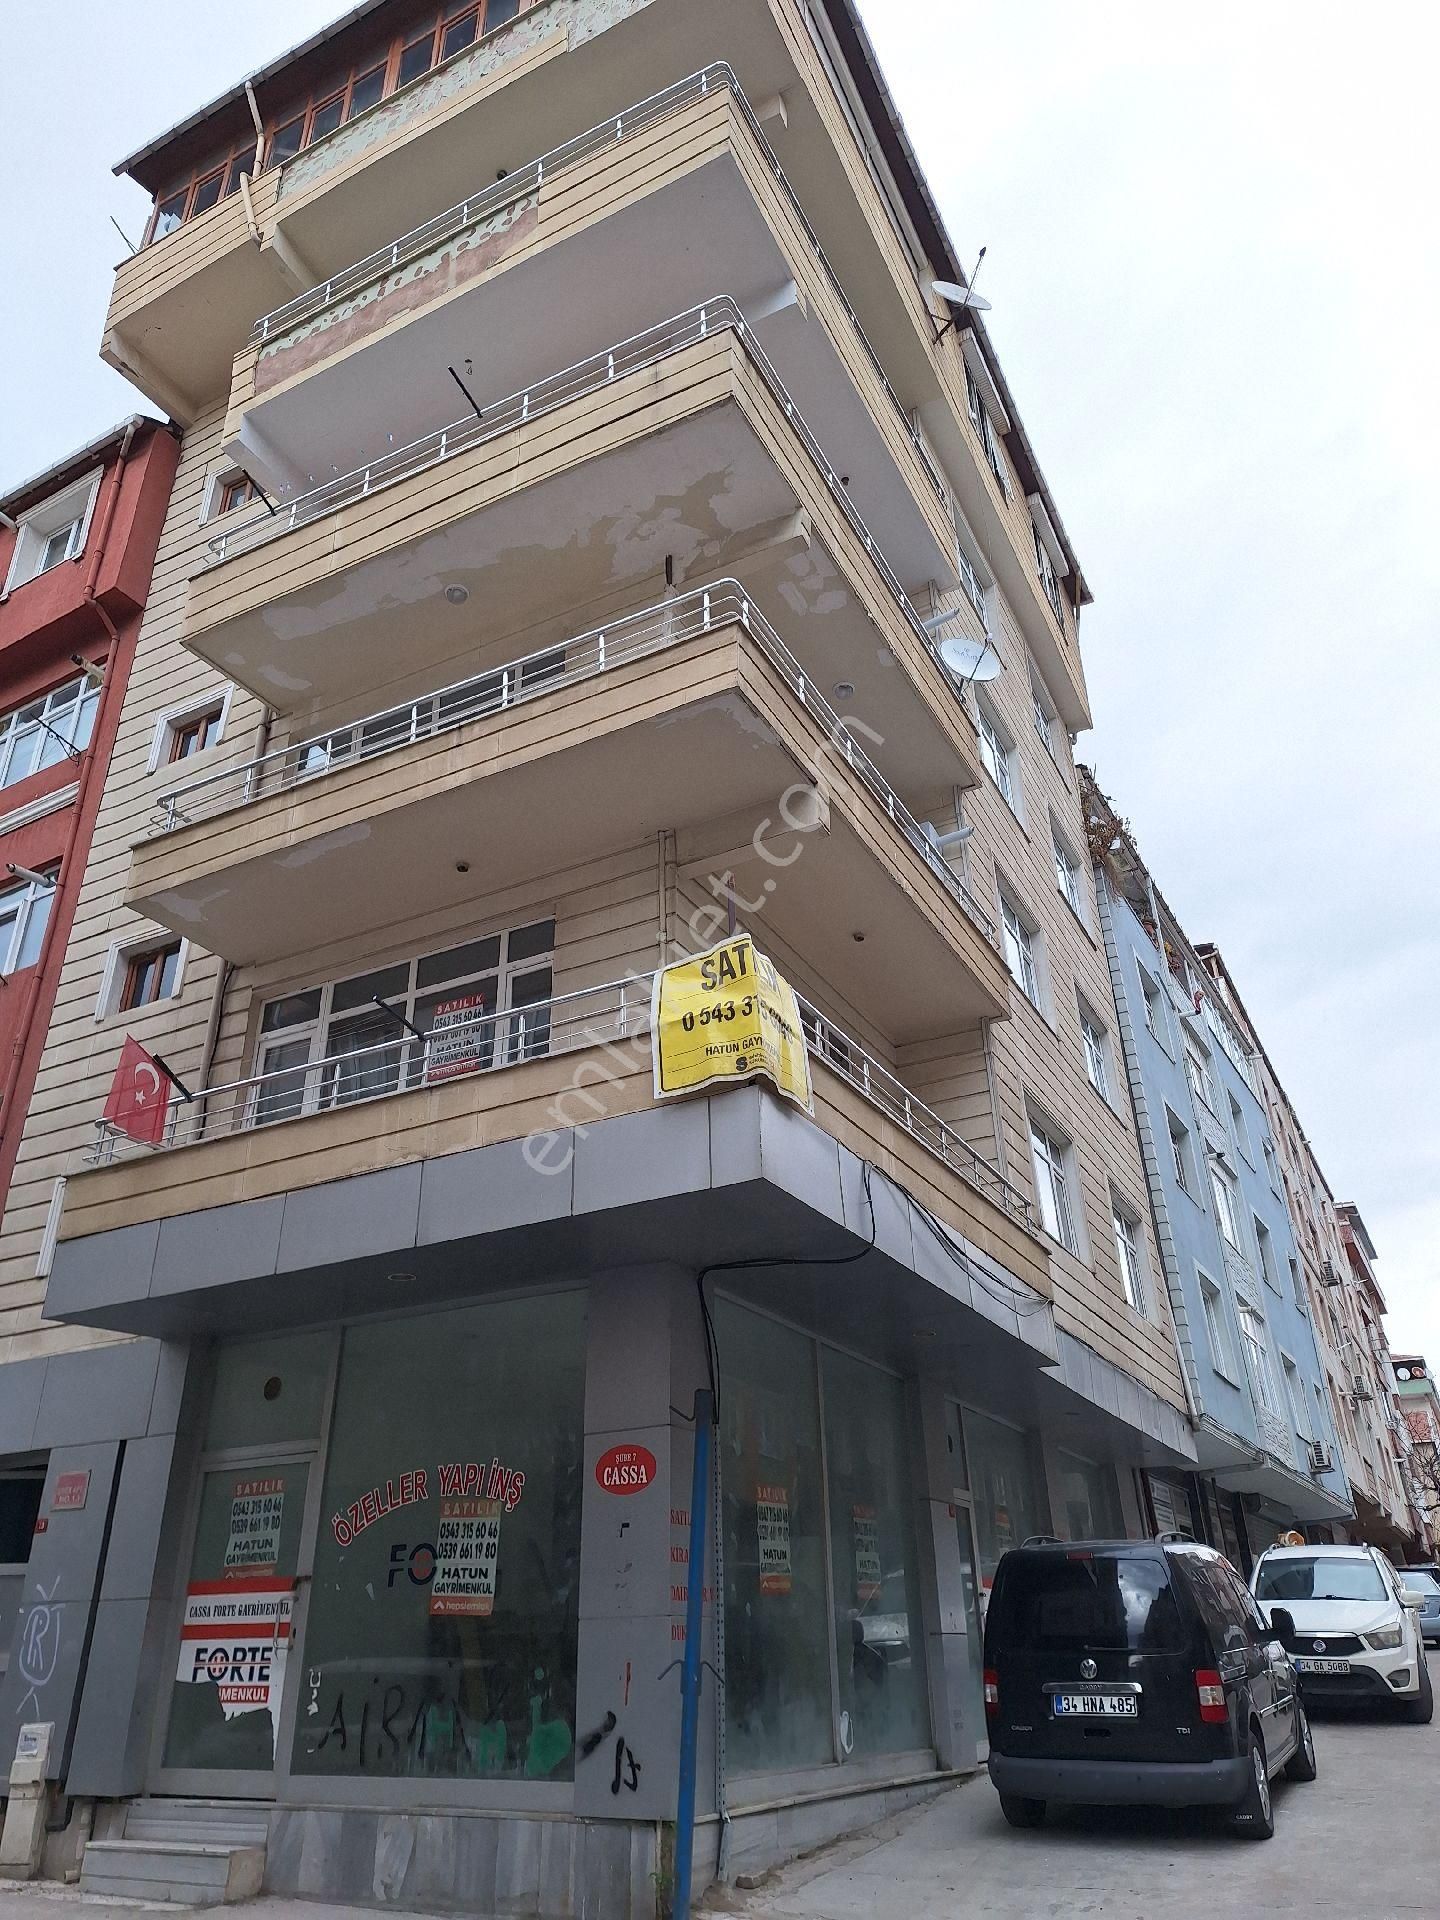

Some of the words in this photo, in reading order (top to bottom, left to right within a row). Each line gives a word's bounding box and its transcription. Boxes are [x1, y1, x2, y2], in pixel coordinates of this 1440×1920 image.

[436, 995, 482, 1014] SATILIK
[700, 1000, 735, 1026] 543
[705, 1041, 740, 1057] HATUN
[615, 1453, 632, 1465] ŞUBE
[603, 1464, 649, 1486] CASSA
[236, 1479, 284, 1496] SATILIK
[331, 1468, 428, 1547] ÖZELLER
[438, 1463, 486, 1497] YAPI
[486, 1457, 526, 1513] İNŞ
[444, 1502, 499, 1515] SATILIK
[440, 1522, 460, 1539] 0543
[461, 1522, 474, 1539] 315
[475, 1522, 487, 1539] 60
[487, 1522, 498, 1539] 46
[233, 1538, 273, 1552] HATUN
[438, 1542, 458, 1560] 0539
[460, 1542, 473, 1559] 661
[474, 1541, 484, 1559] 19
[485, 1541, 497, 1559] 80
[441, 1567, 489, 1580] HATUN
[189, 1604, 212, 1618] CASSA
[213, 1603, 237, 1618] FORTE
[192, 1646, 274, 1683] FORTE
[1063, 1696, 1078, 1712] 34
[1082, 1696, 1106, 1712] HNA
[1109, 1697, 1133, 1713] 485
